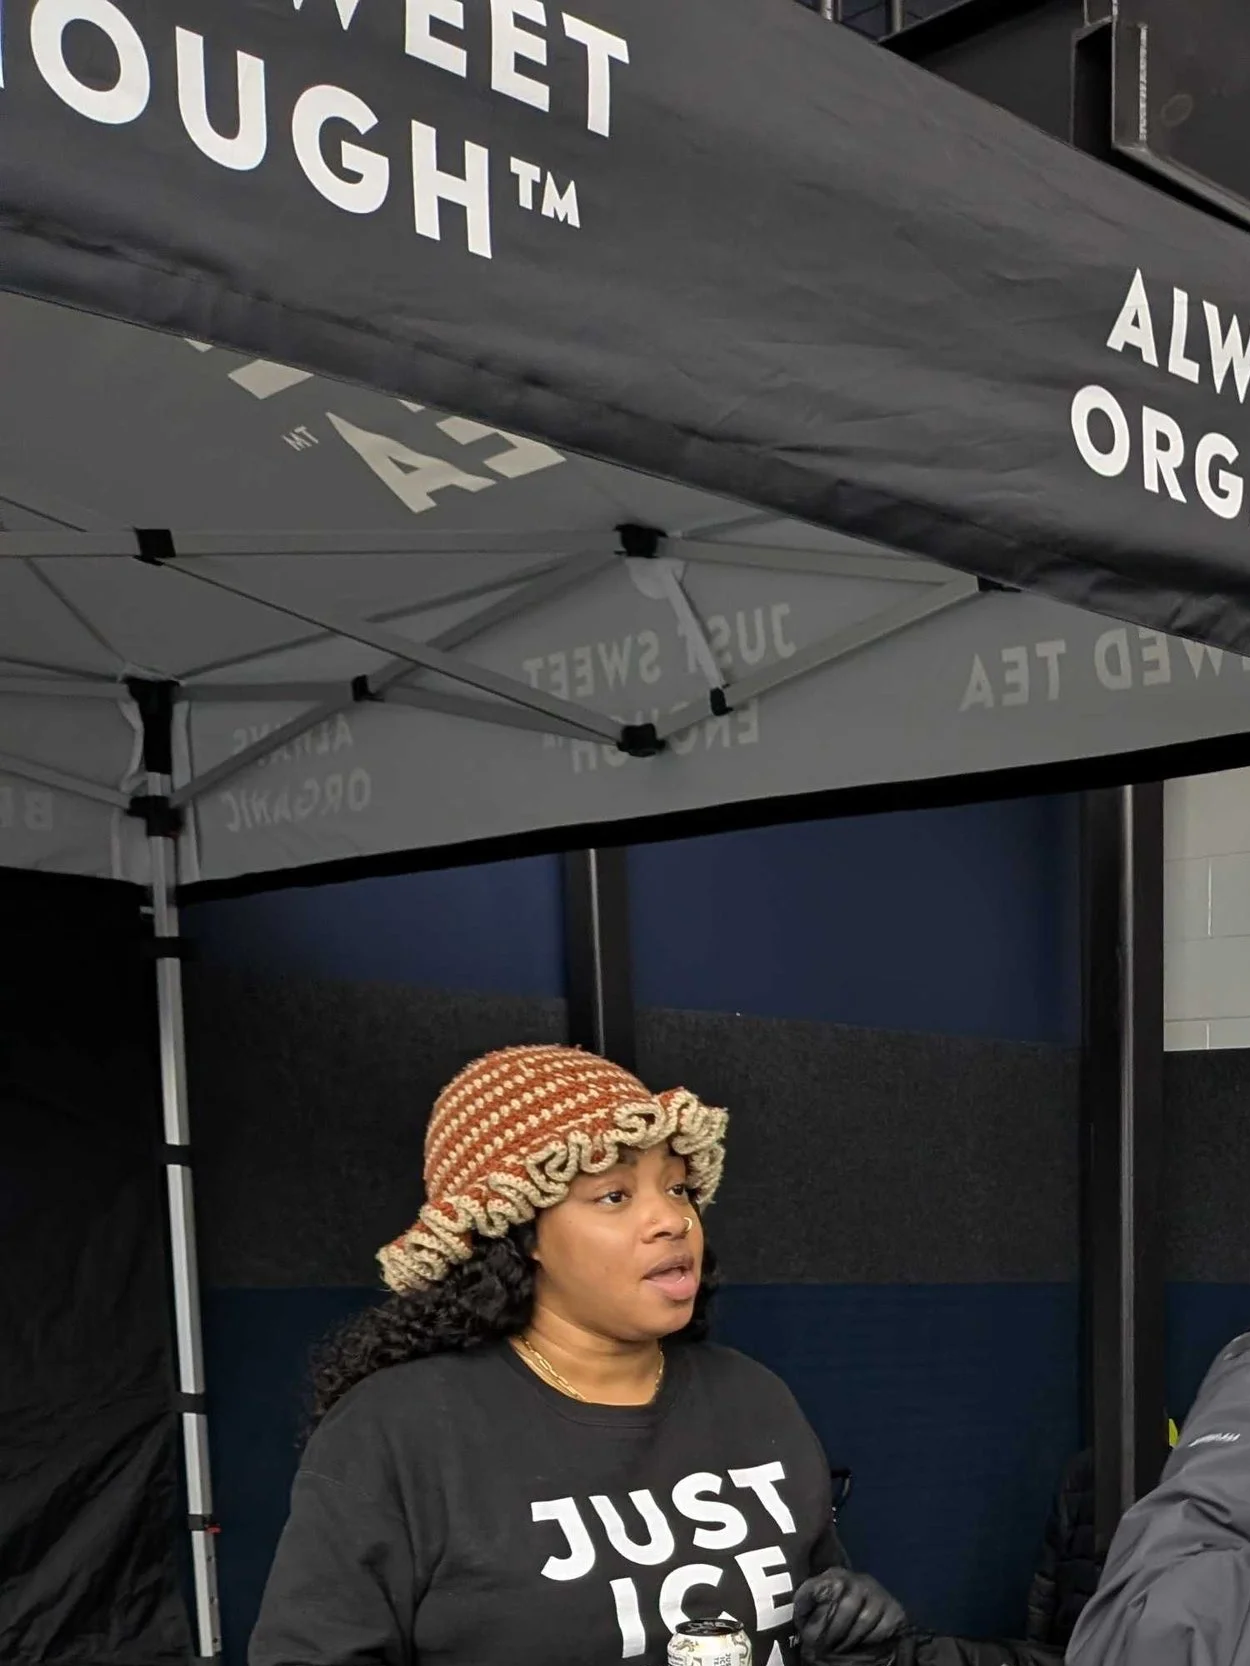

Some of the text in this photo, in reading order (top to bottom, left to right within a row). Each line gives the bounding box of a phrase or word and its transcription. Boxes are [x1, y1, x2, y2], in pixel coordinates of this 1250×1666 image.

[0, 0, 580, 258] OUGH™
[293, 0, 629, 138] EET
[531, 1461, 797, 1581] JUST
[609, 1545, 795, 1658] ICE
